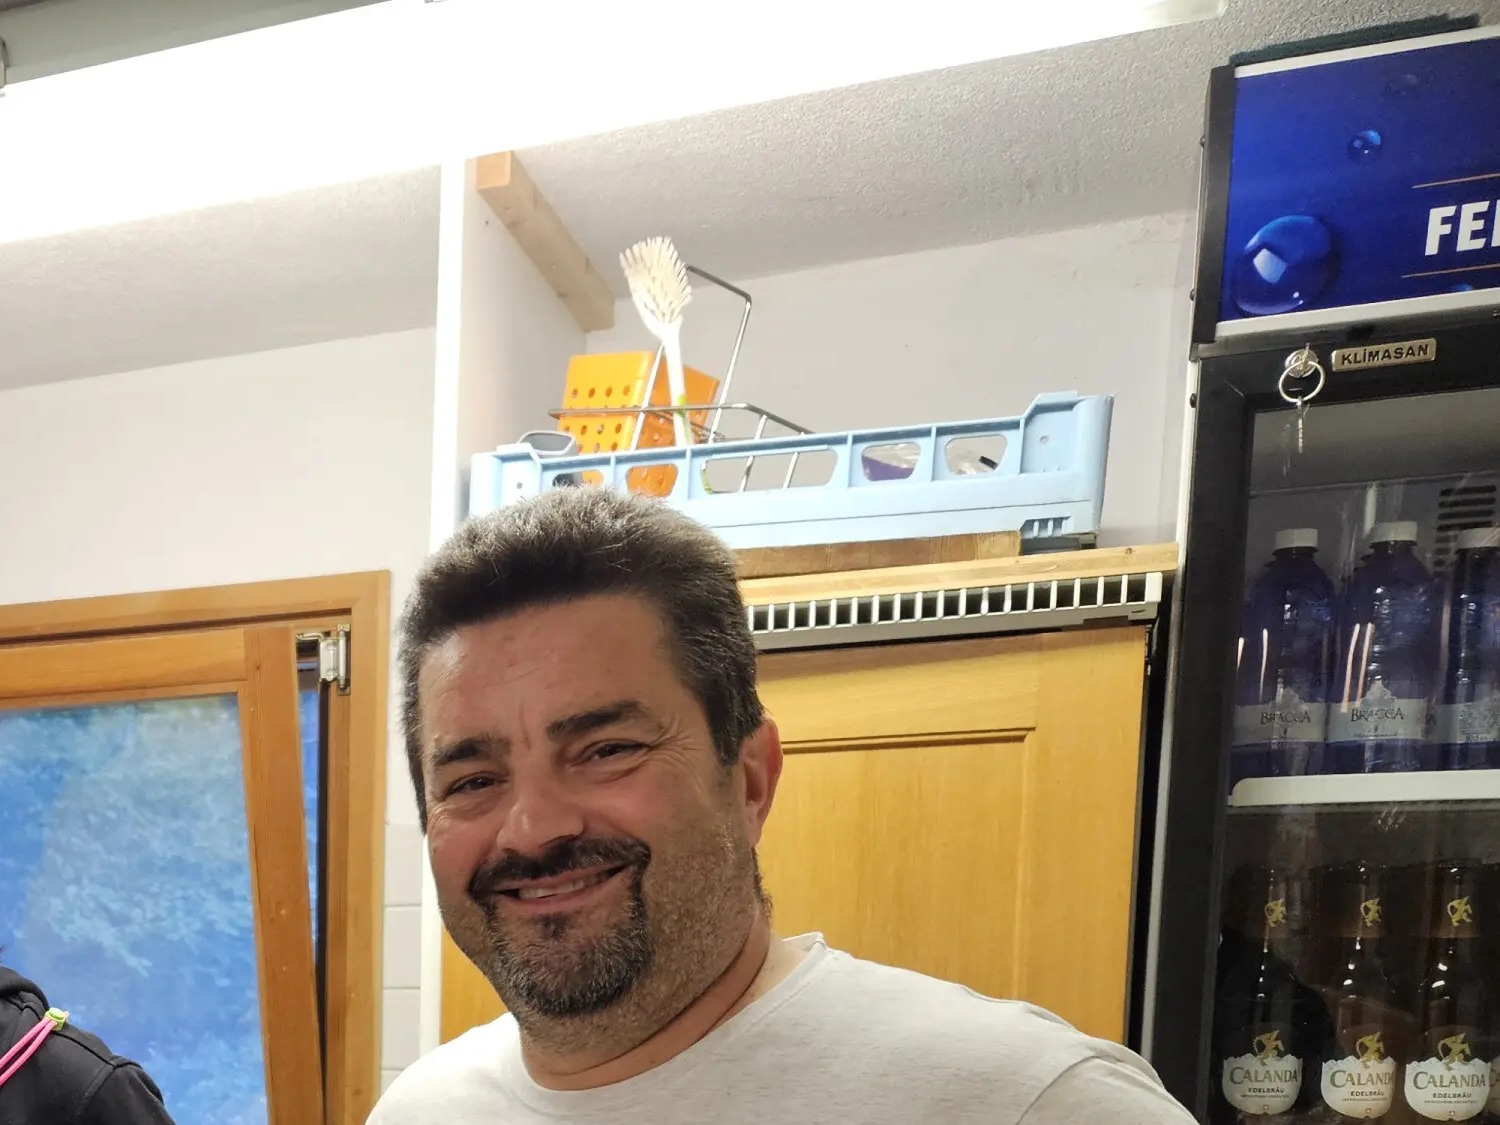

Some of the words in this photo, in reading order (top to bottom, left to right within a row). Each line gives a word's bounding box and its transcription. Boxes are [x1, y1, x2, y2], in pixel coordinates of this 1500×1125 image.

[1425, 199, 1500, 256] FE
[1260, 710, 1311, 725] BRACCA
[1351, 707, 1404, 722] BRACCA
[1229, 1066, 1298, 1085] CALANDA
[1413, 1071, 1486, 1090] CALANDA
